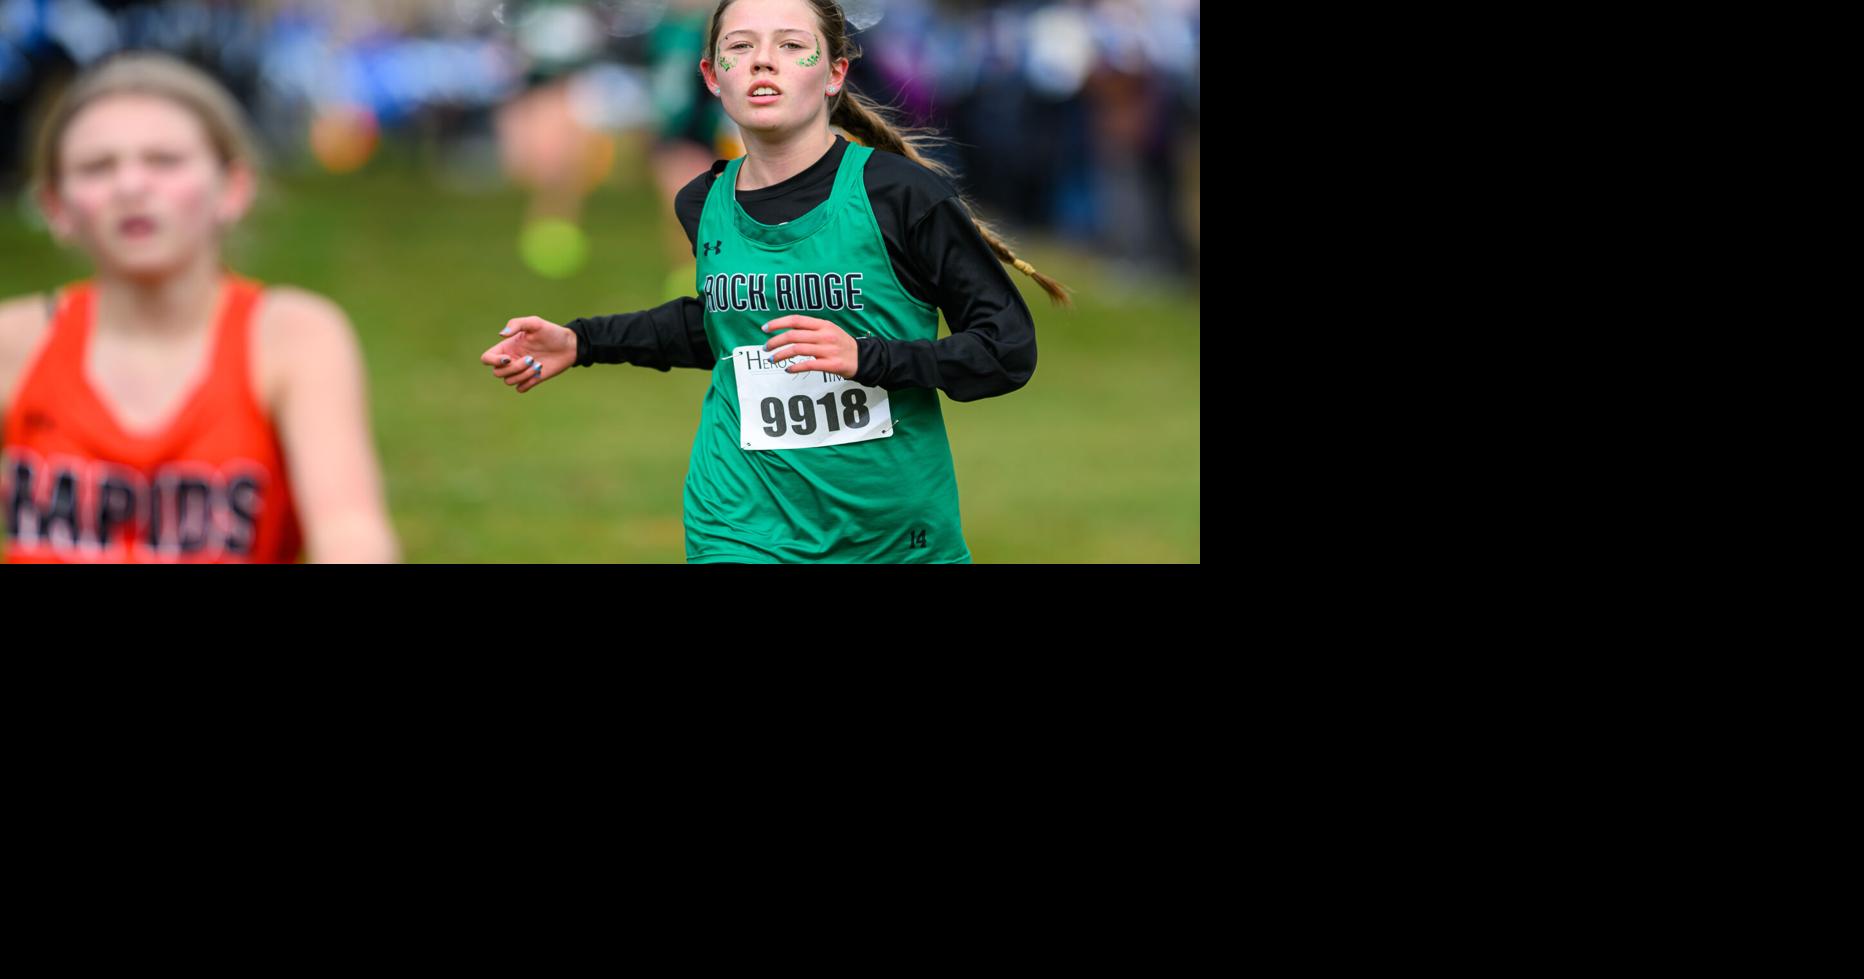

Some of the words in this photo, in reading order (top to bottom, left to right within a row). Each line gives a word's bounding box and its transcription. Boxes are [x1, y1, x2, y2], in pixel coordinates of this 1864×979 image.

[704, 272, 768, 313] ROCK
[775, 272, 864, 312] RIDGE
[760, 388, 870, 438] 9918
[4, 455, 262, 558] RAPIDS
[909, 529, 927, 549] 14
